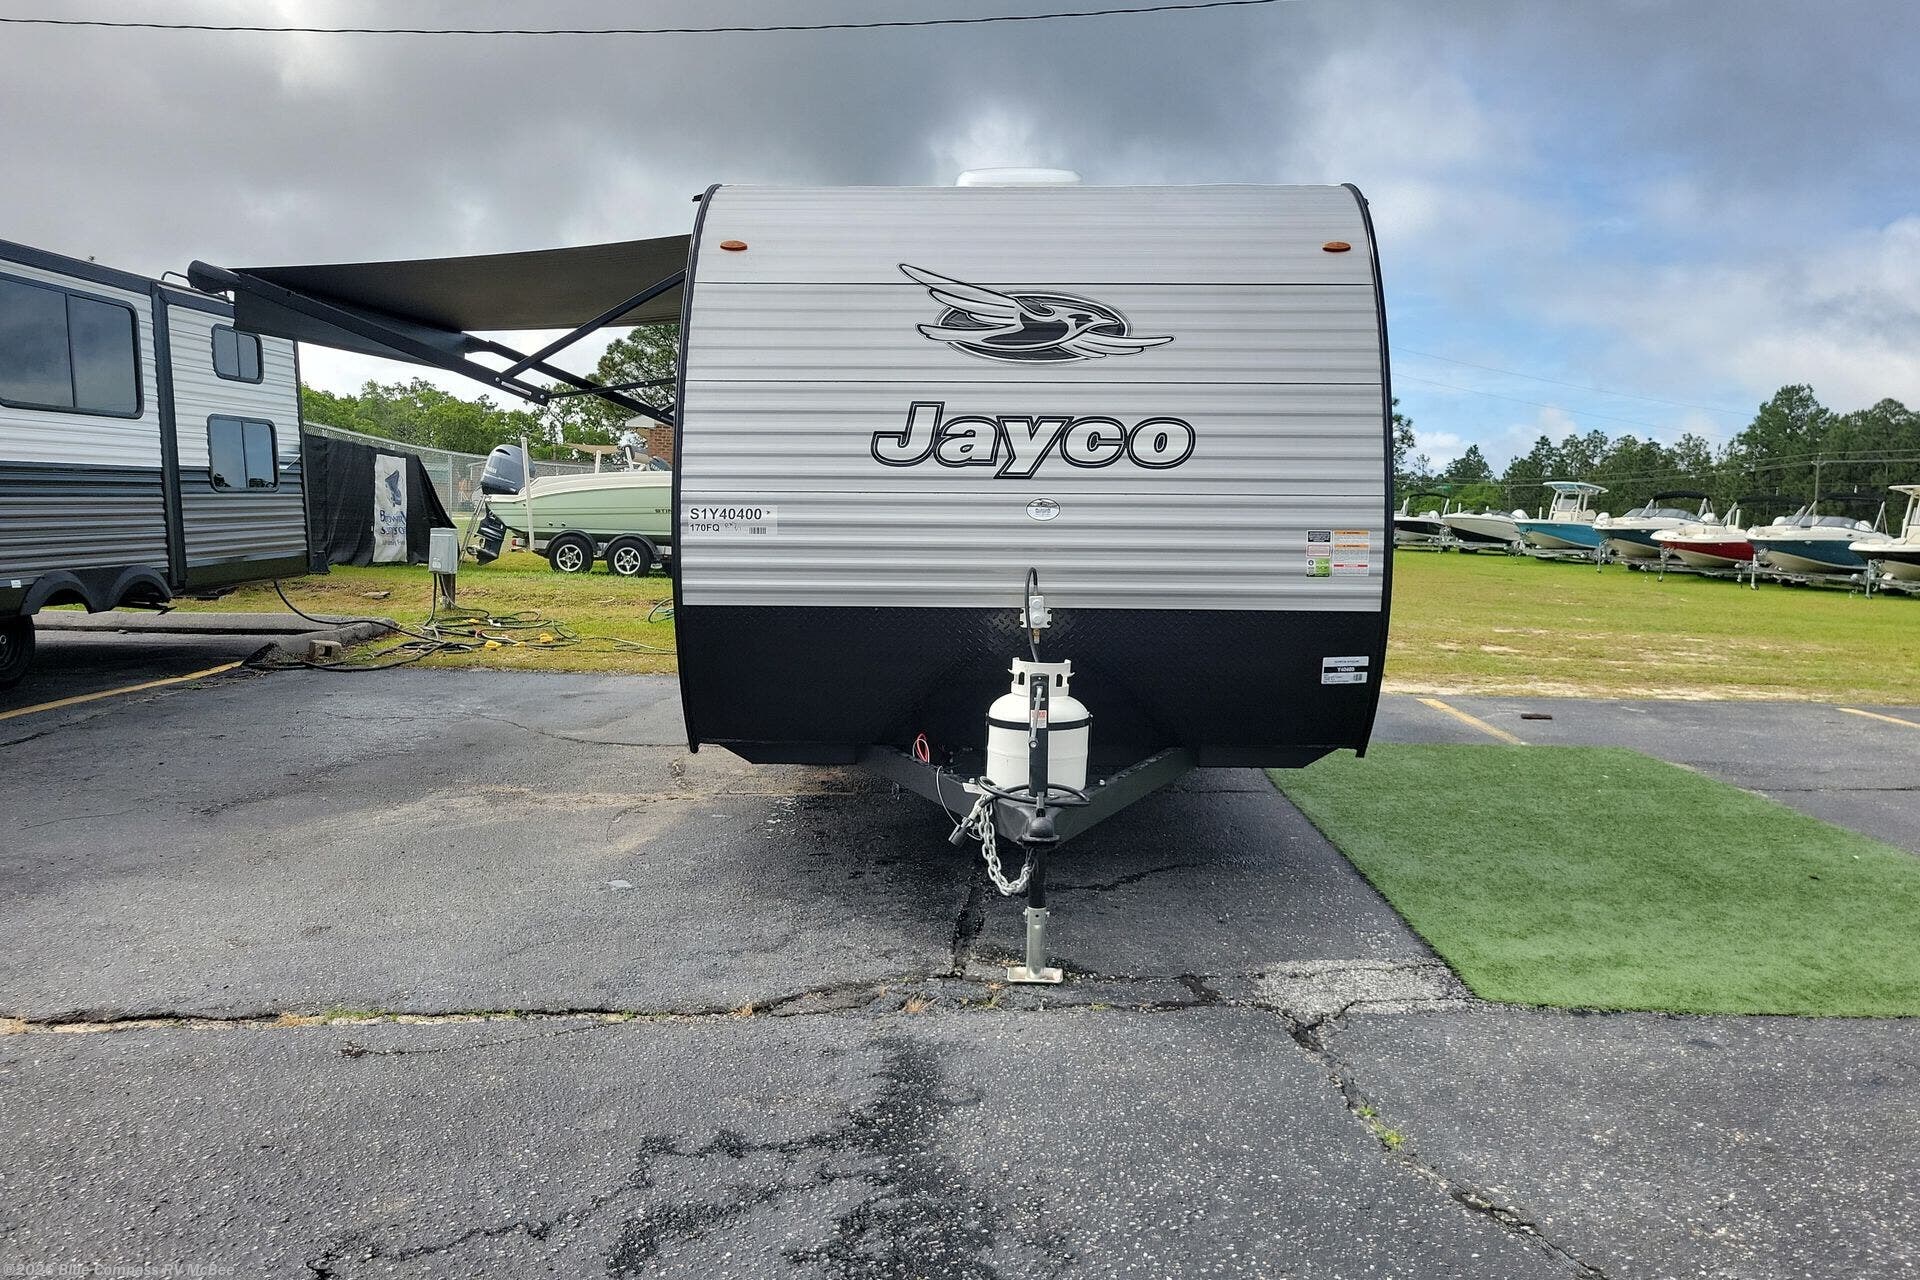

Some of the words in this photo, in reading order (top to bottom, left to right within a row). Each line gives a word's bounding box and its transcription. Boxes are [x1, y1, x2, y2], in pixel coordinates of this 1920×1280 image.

[870, 401, 1196, 480] Jayco
[689, 507, 762, 520] S1Y40400
[689, 523, 720, 532] 170FQ
